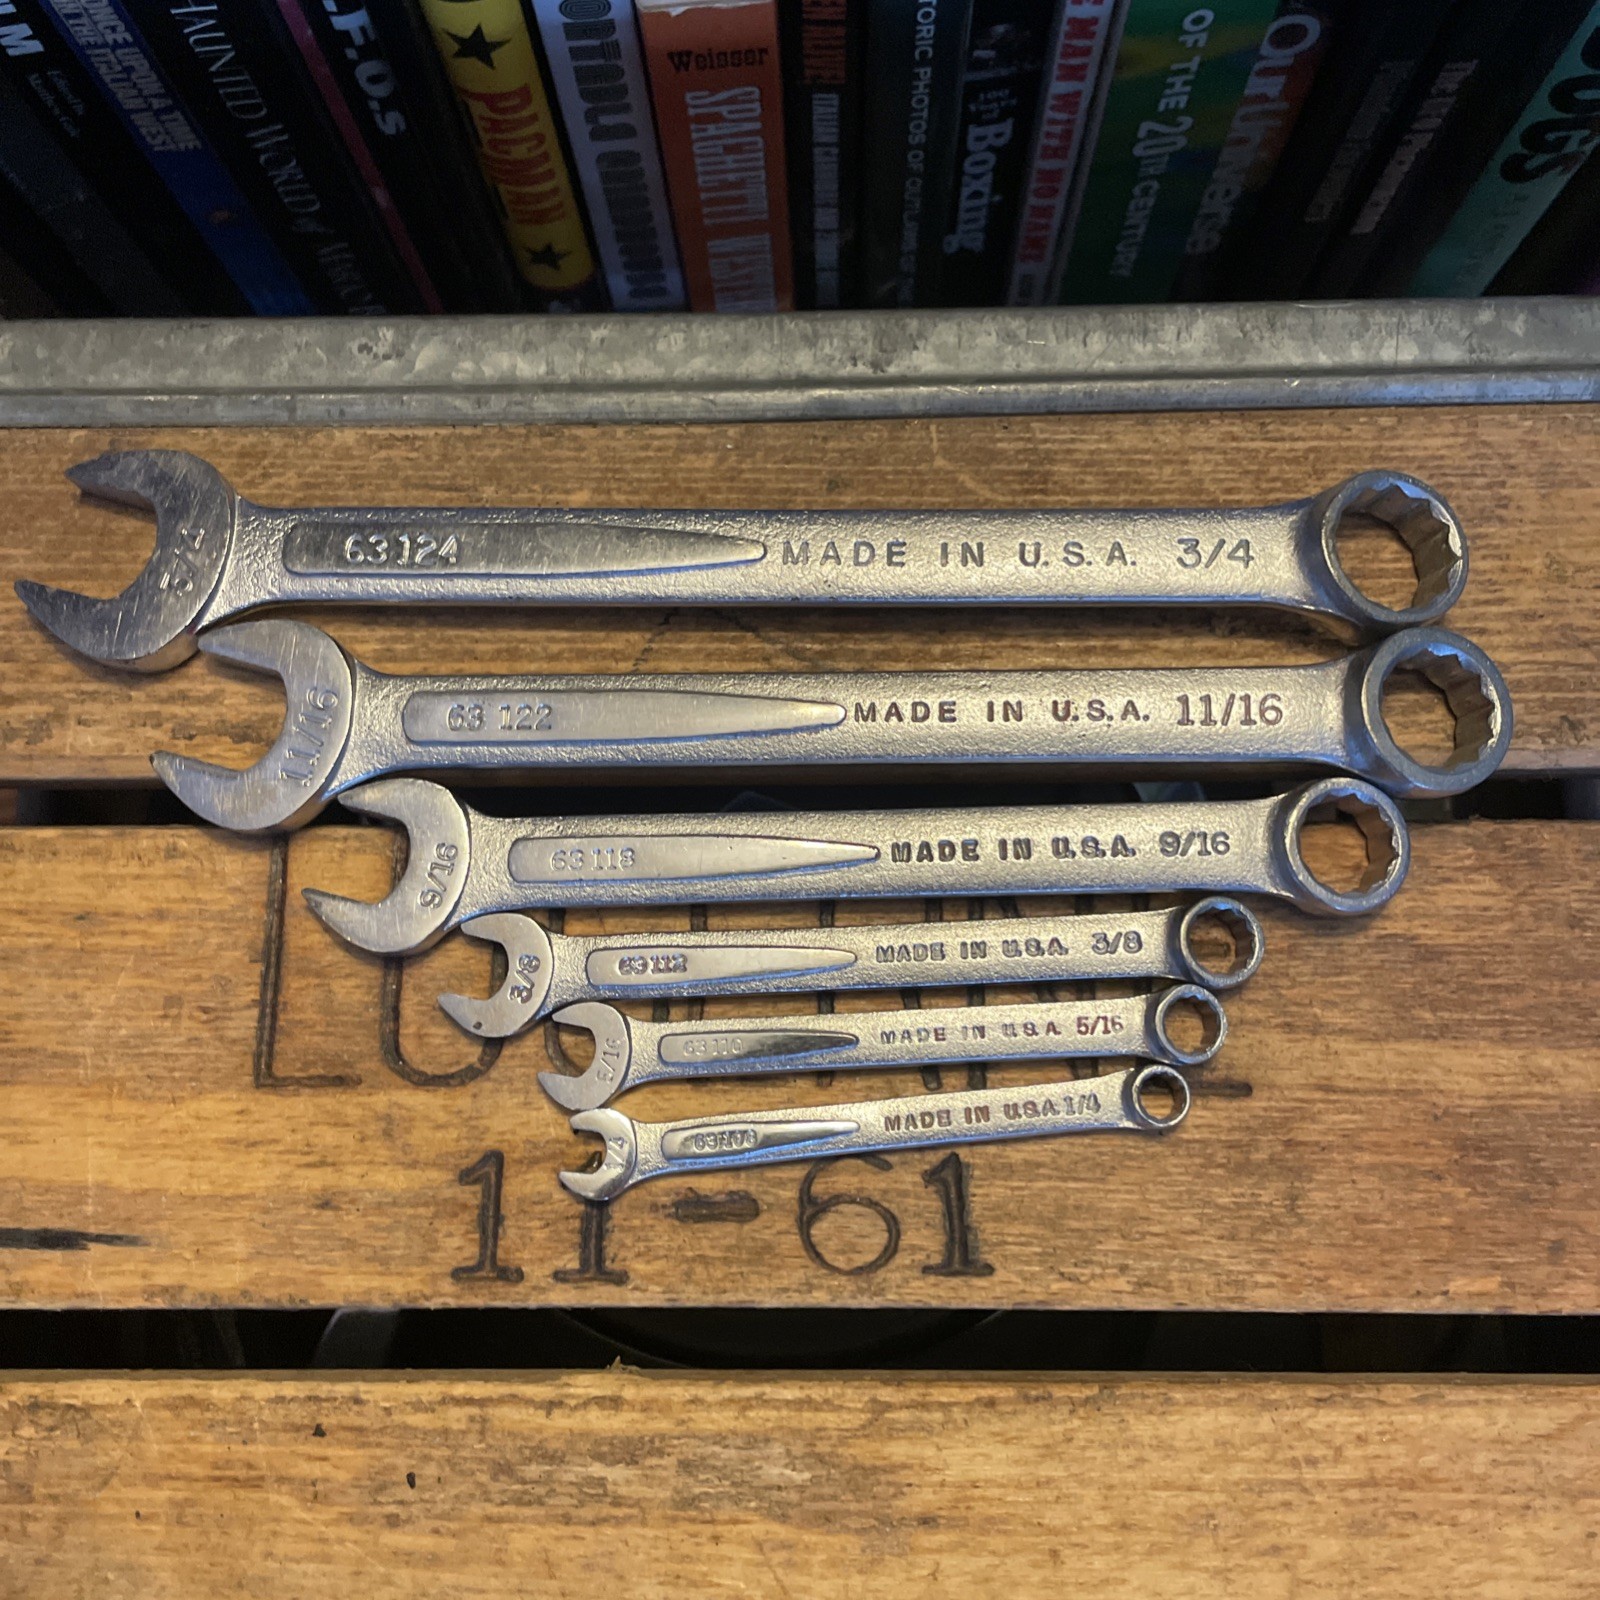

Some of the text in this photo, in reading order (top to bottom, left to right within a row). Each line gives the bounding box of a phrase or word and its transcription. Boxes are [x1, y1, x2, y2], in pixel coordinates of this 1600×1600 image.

[1056, 17, 1099, 82] MAN
[1179, 8, 1216, 48] OF
[666, 46, 769, 74] Weisser
[1156, 55, 1201, 112] THE
[909, 66, 933, 145] PHOTOS
[1040, 91, 1083, 161] WITH
[685, 85, 769, 226] SPAGHETTI
[906, 149, 926, 173] OF
[943, 118, 1014, 254] Boxing
[1110, 178, 1161, 278] CENTURY
[782, 538, 1255, 569] MADE IN U.S.A. 3/4
[853, 693, 1284, 726] MADE IN U.S.A. 11/16
[280, 686, 338, 787] 11/16
[891, 830, 1231, 863] MADE IN U.S.A. 9/16
[419, 842, 458, 909] 9/16
[875, 941, 946, 964] MADE
[960, 939, 988, 960] IN
[1091, 930, 1144, 955] 3/8
[509, 954, 541, 1004] 3/8
[880, 1027, 946, 1045] MADE
[961, 1024, 987, 1041] IN
[1076, 1014, 1125, 1036] 5/16
[884, 1108, 951, 1132] MADE
[964, 1105, 990, 1125] IN
